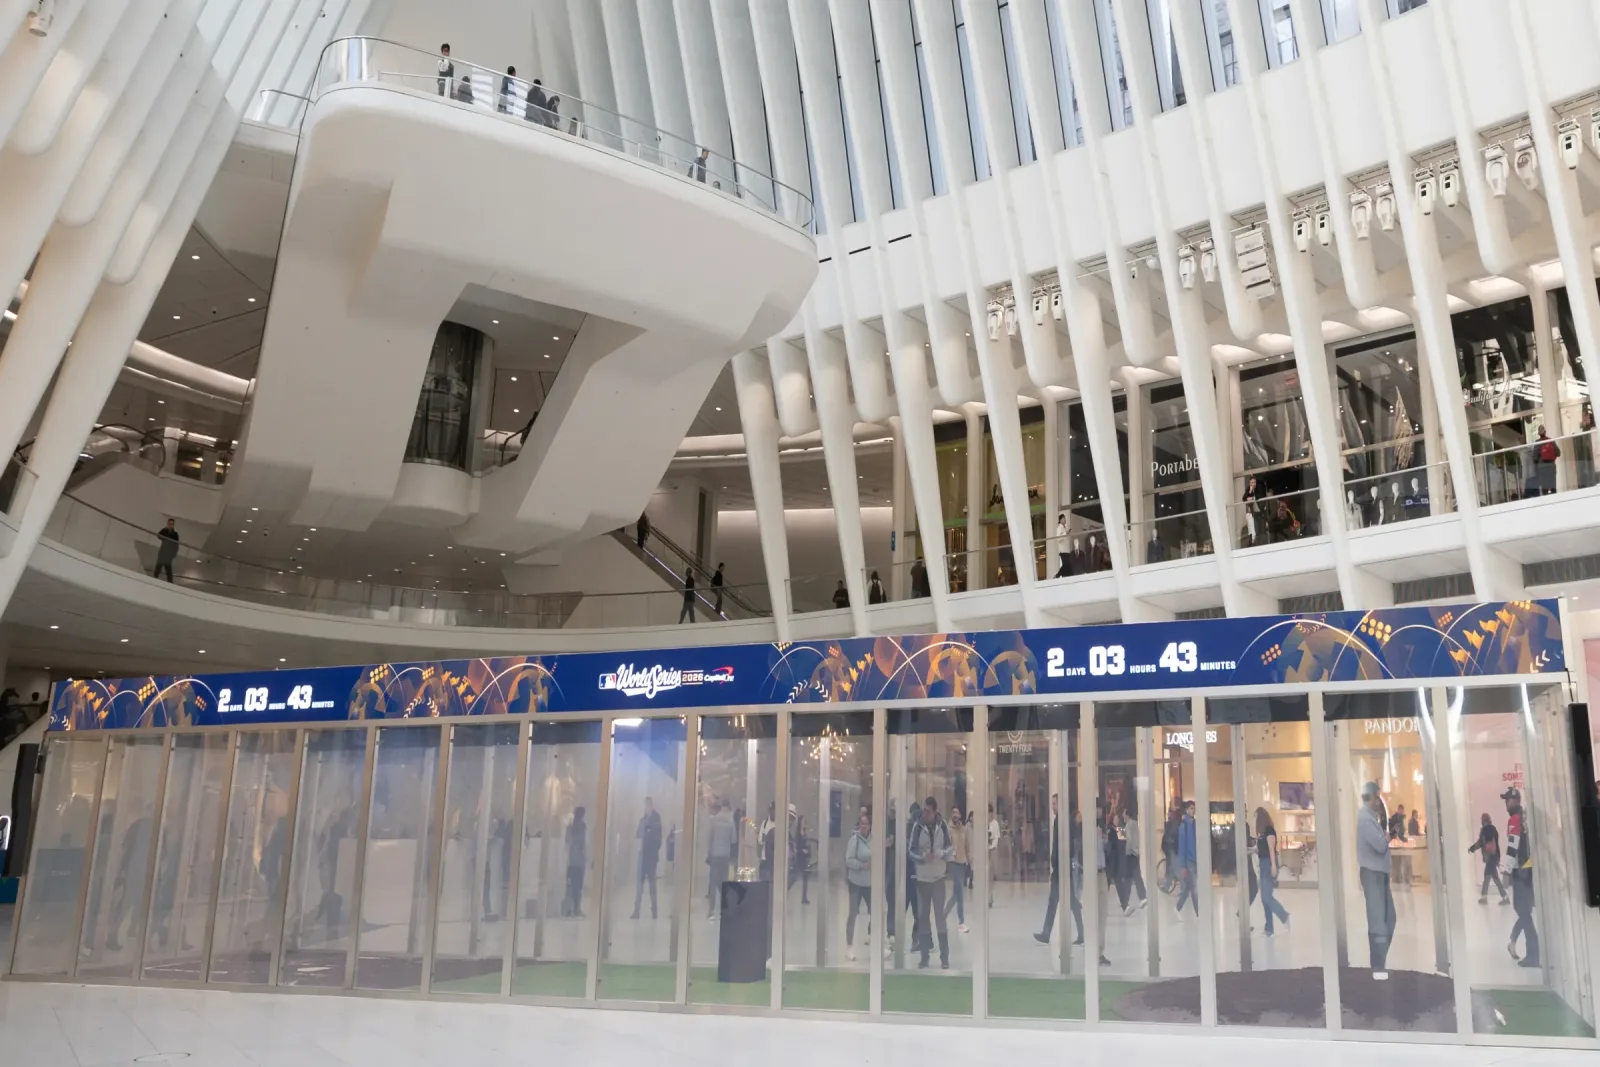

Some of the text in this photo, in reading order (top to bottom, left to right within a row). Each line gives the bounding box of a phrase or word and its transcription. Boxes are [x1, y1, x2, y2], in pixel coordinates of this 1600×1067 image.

[1047, 641, 1236, 677] 2 DAYS 03 HOURS 43 MINUTES
[616, 663, 652, 691] World
[646, 664, 682, 699] Series
[218, 688, 231, 712] 2
[244, 687, 269, 712] 03
[287, 684, 313, 709] 43
[998, 744, 1018, 754] TWENTY
[1166, 730, 1217, 745] LONGES
